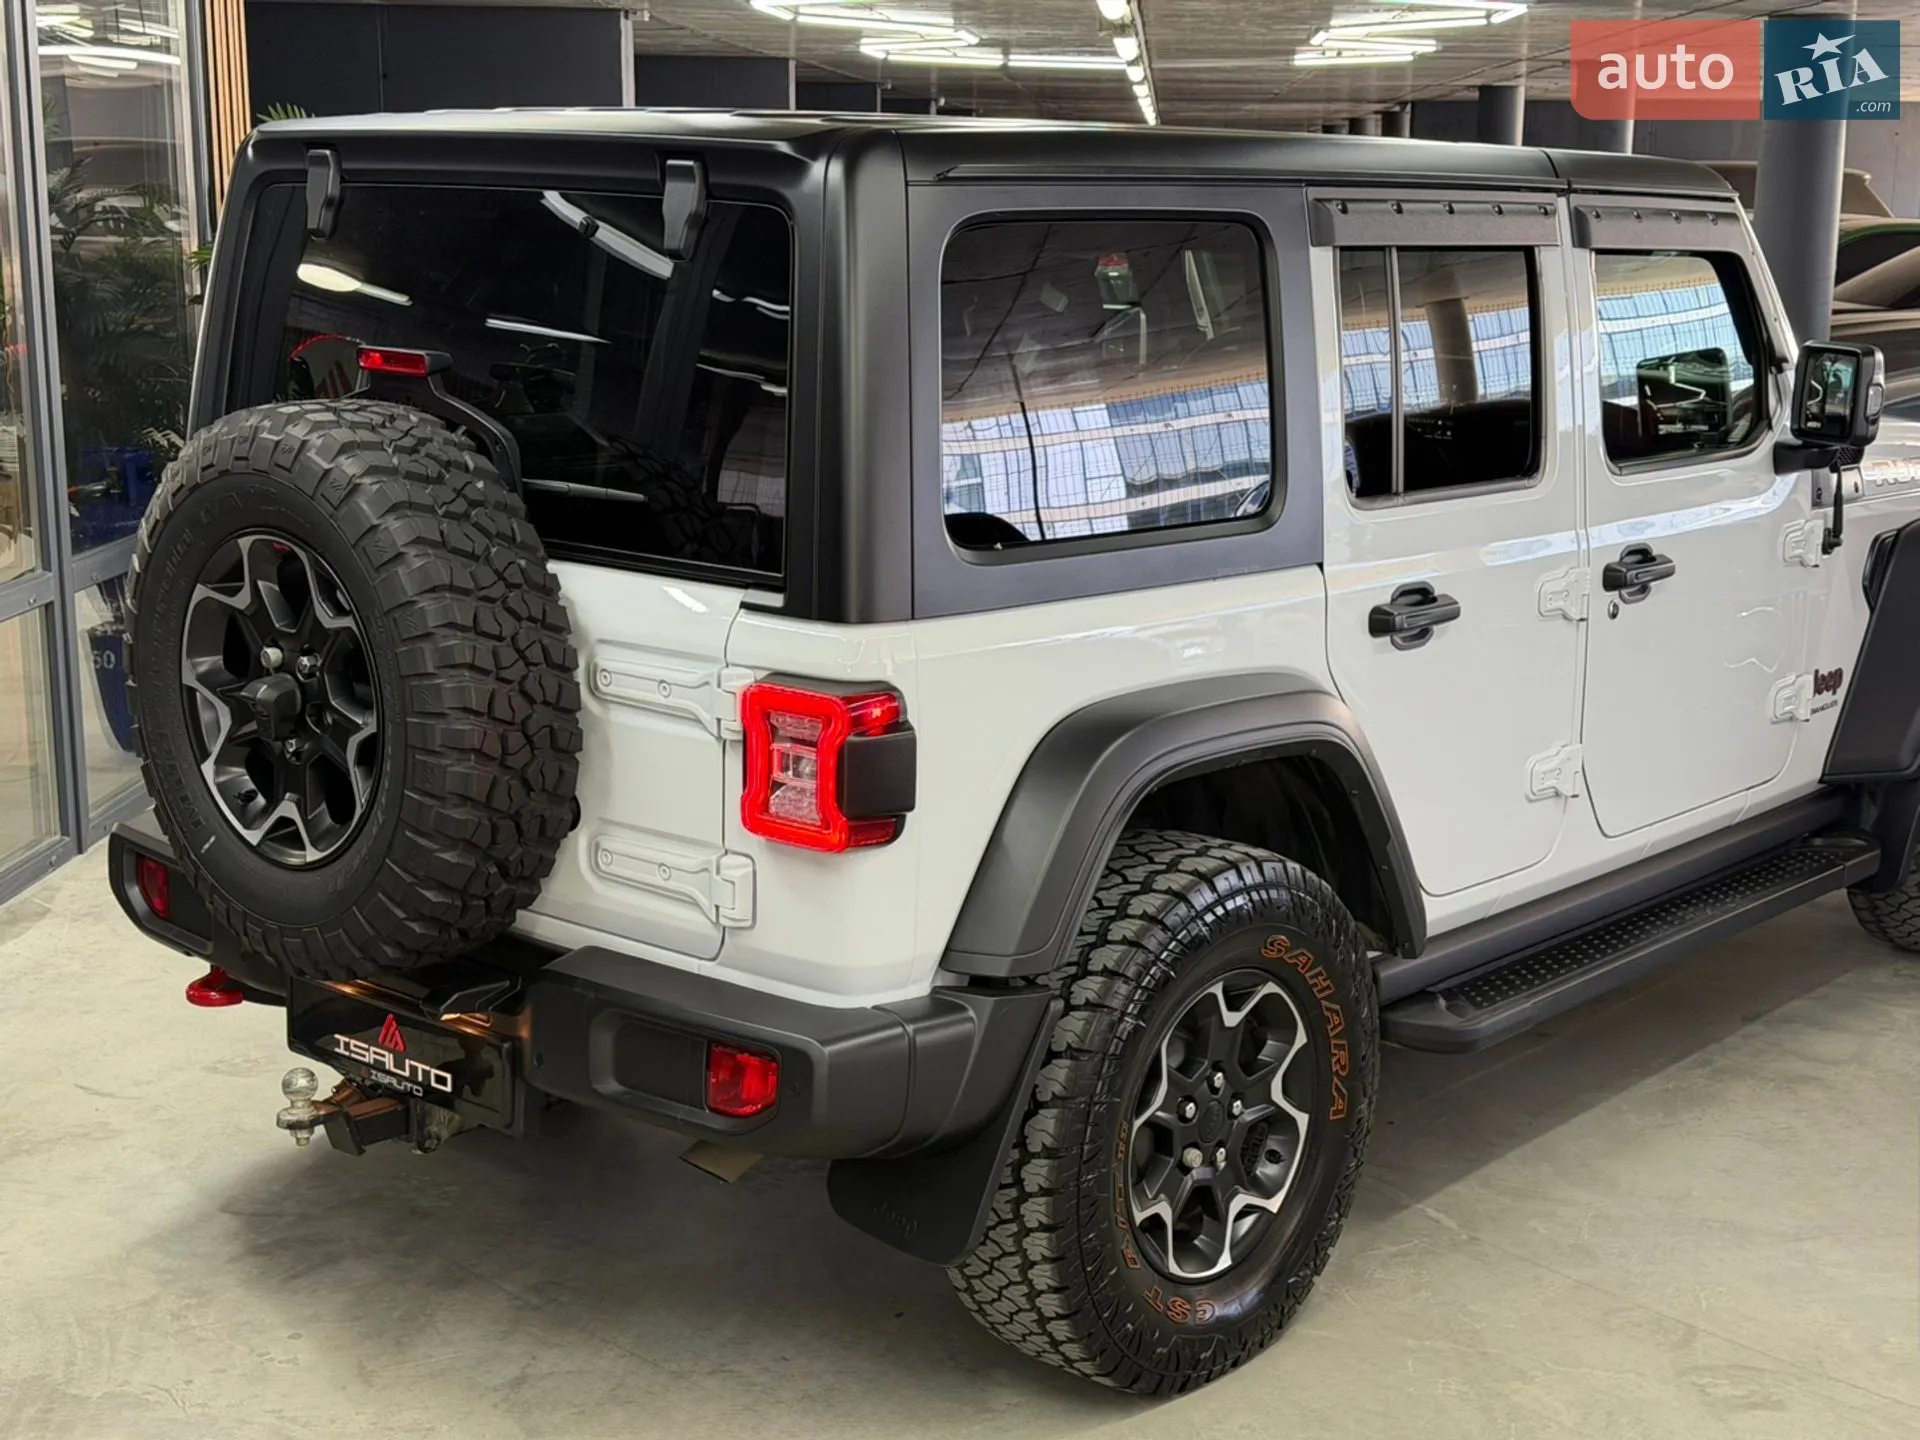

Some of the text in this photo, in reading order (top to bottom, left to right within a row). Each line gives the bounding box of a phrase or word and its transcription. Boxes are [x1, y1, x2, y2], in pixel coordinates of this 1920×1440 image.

[1260, 934, 1350, 1121] SAHARA
[333, 1033, 453, 1093] ISAUTO
[369, 1068, 424, 1097] ISAUTO
[1143, 1285, 1217, 1325] CST
